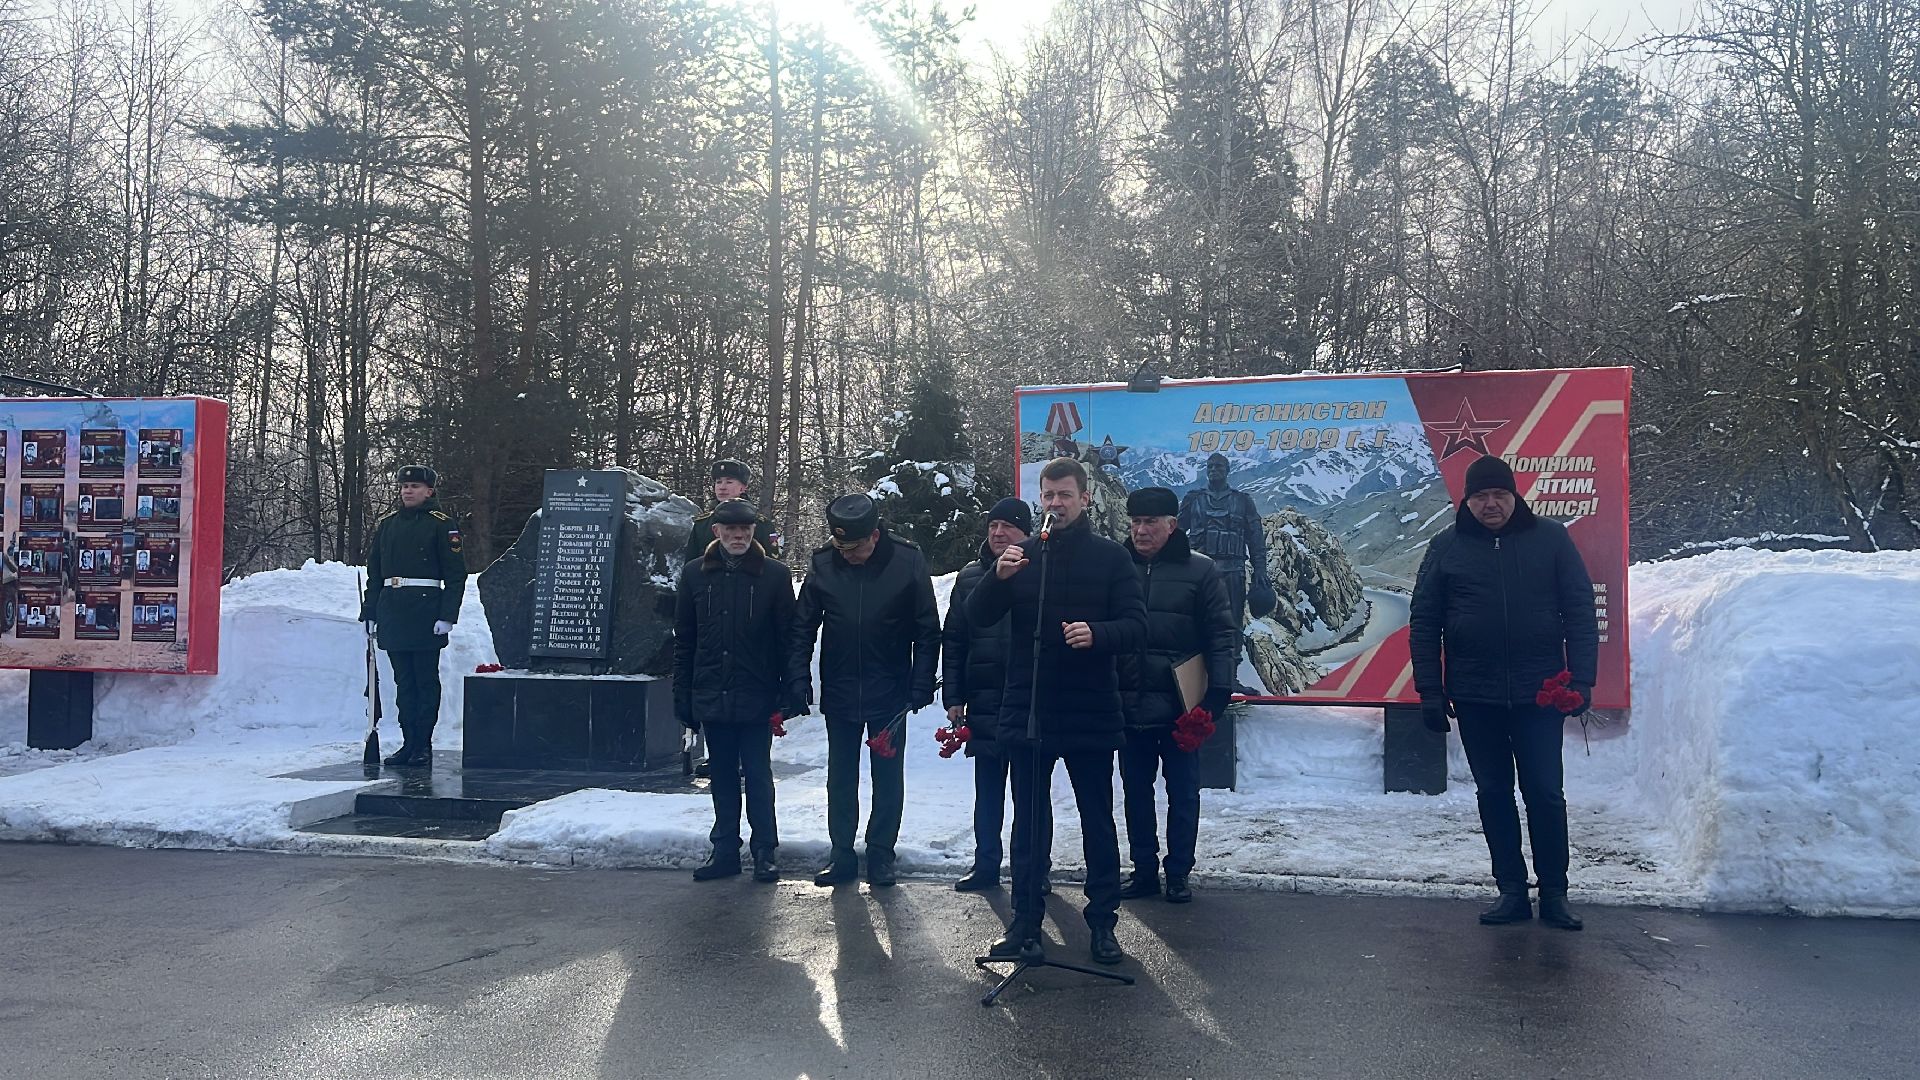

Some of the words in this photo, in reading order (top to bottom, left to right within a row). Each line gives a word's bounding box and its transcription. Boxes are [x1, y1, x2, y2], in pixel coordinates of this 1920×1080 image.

[1193, 400, 1388, 424] Афганистан
[1188, 427, 1340, 452] 1979-1989
[1344, 430, 1365, 449] г.
[1373, 429, 1394, 448] г.
[1536, 477, 1597, 496] чтим,
